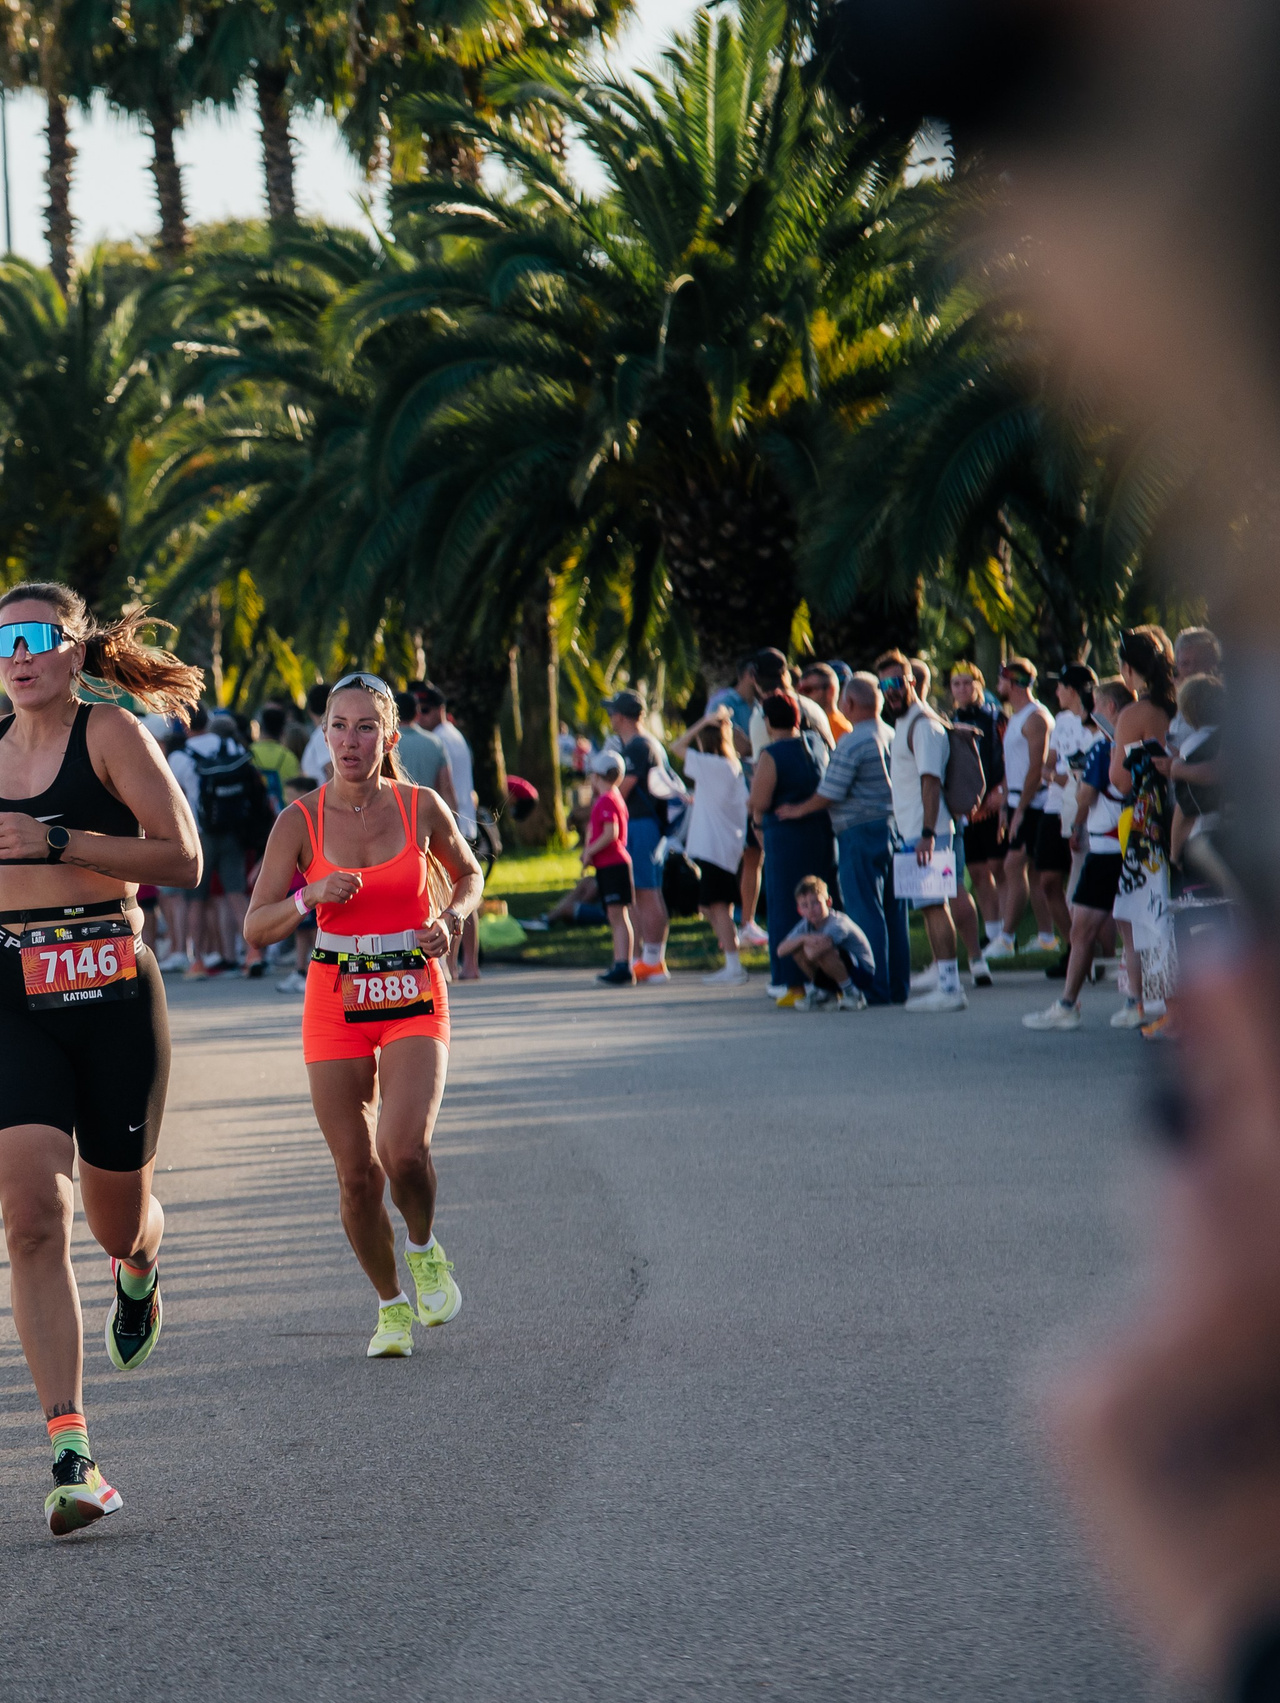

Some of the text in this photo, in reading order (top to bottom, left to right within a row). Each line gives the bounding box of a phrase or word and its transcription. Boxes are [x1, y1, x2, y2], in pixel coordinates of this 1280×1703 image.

[32, 936, 46, 944] LADY
[40, 945, 117, 983] 7146
[63, 988, 103, 1002] КАТЮША
[353, 975, 418, 1003] 7888
